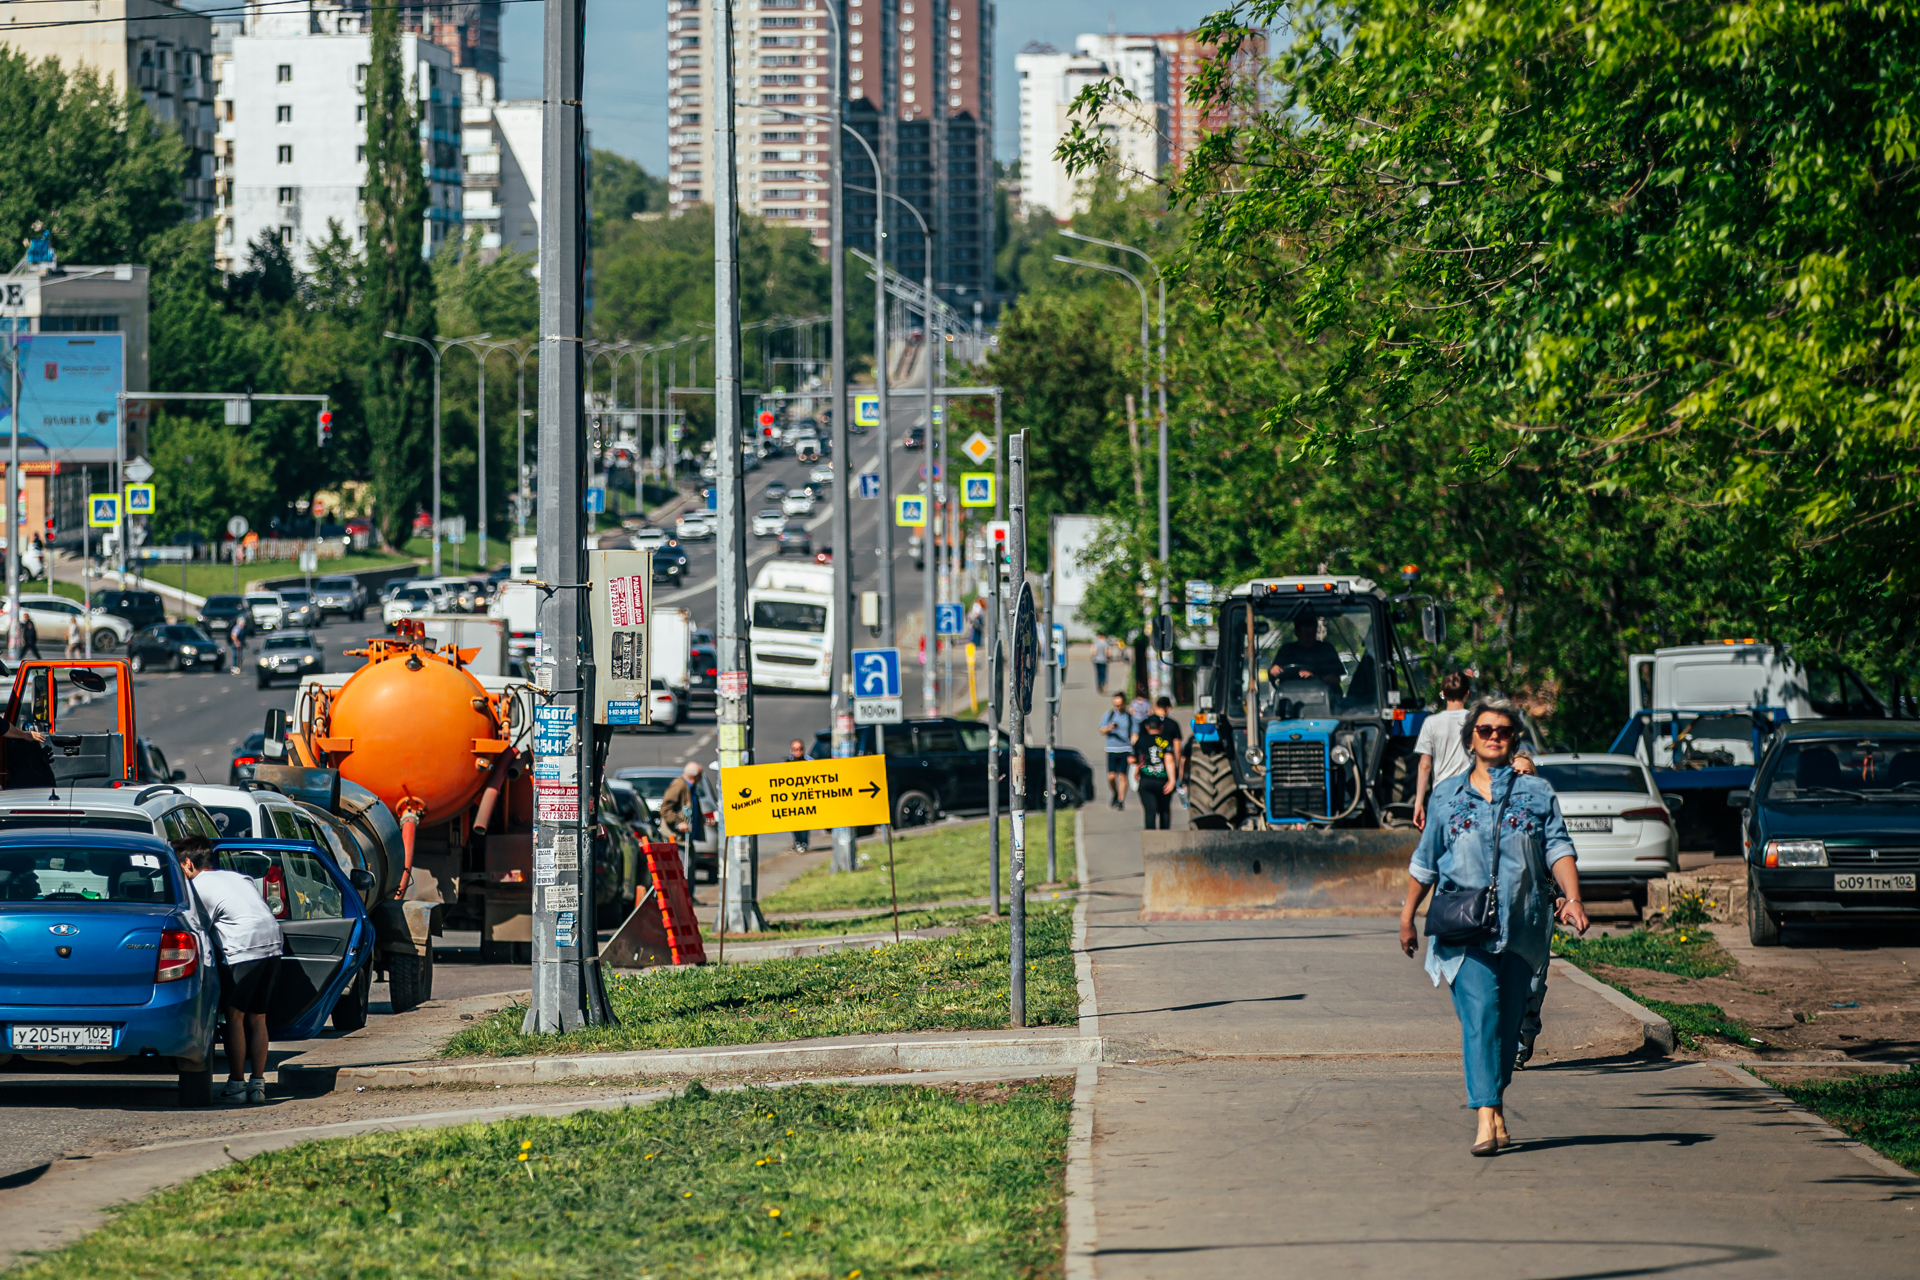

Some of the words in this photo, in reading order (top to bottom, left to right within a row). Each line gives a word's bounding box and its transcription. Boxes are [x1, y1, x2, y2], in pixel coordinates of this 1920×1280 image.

[633, 577, 642, 607] РАБОЧИЙ
[634, 608, 643, 623] ДОМ
[536, 708, 574, 720] РАБОТА
[769, 773, 839, 788] ПРОДУКТЫ
[770, 793, 788, 803] ПО
[791, 787, 853, 802] УЛЁТНЫМ
[771, 805, 817, 819] ЦЕНАМ
[1892, 875, 1912, 886] 102
[18, 1028, 81, 1043] У205НУ
[84, 1027, 108, 1039] 102
